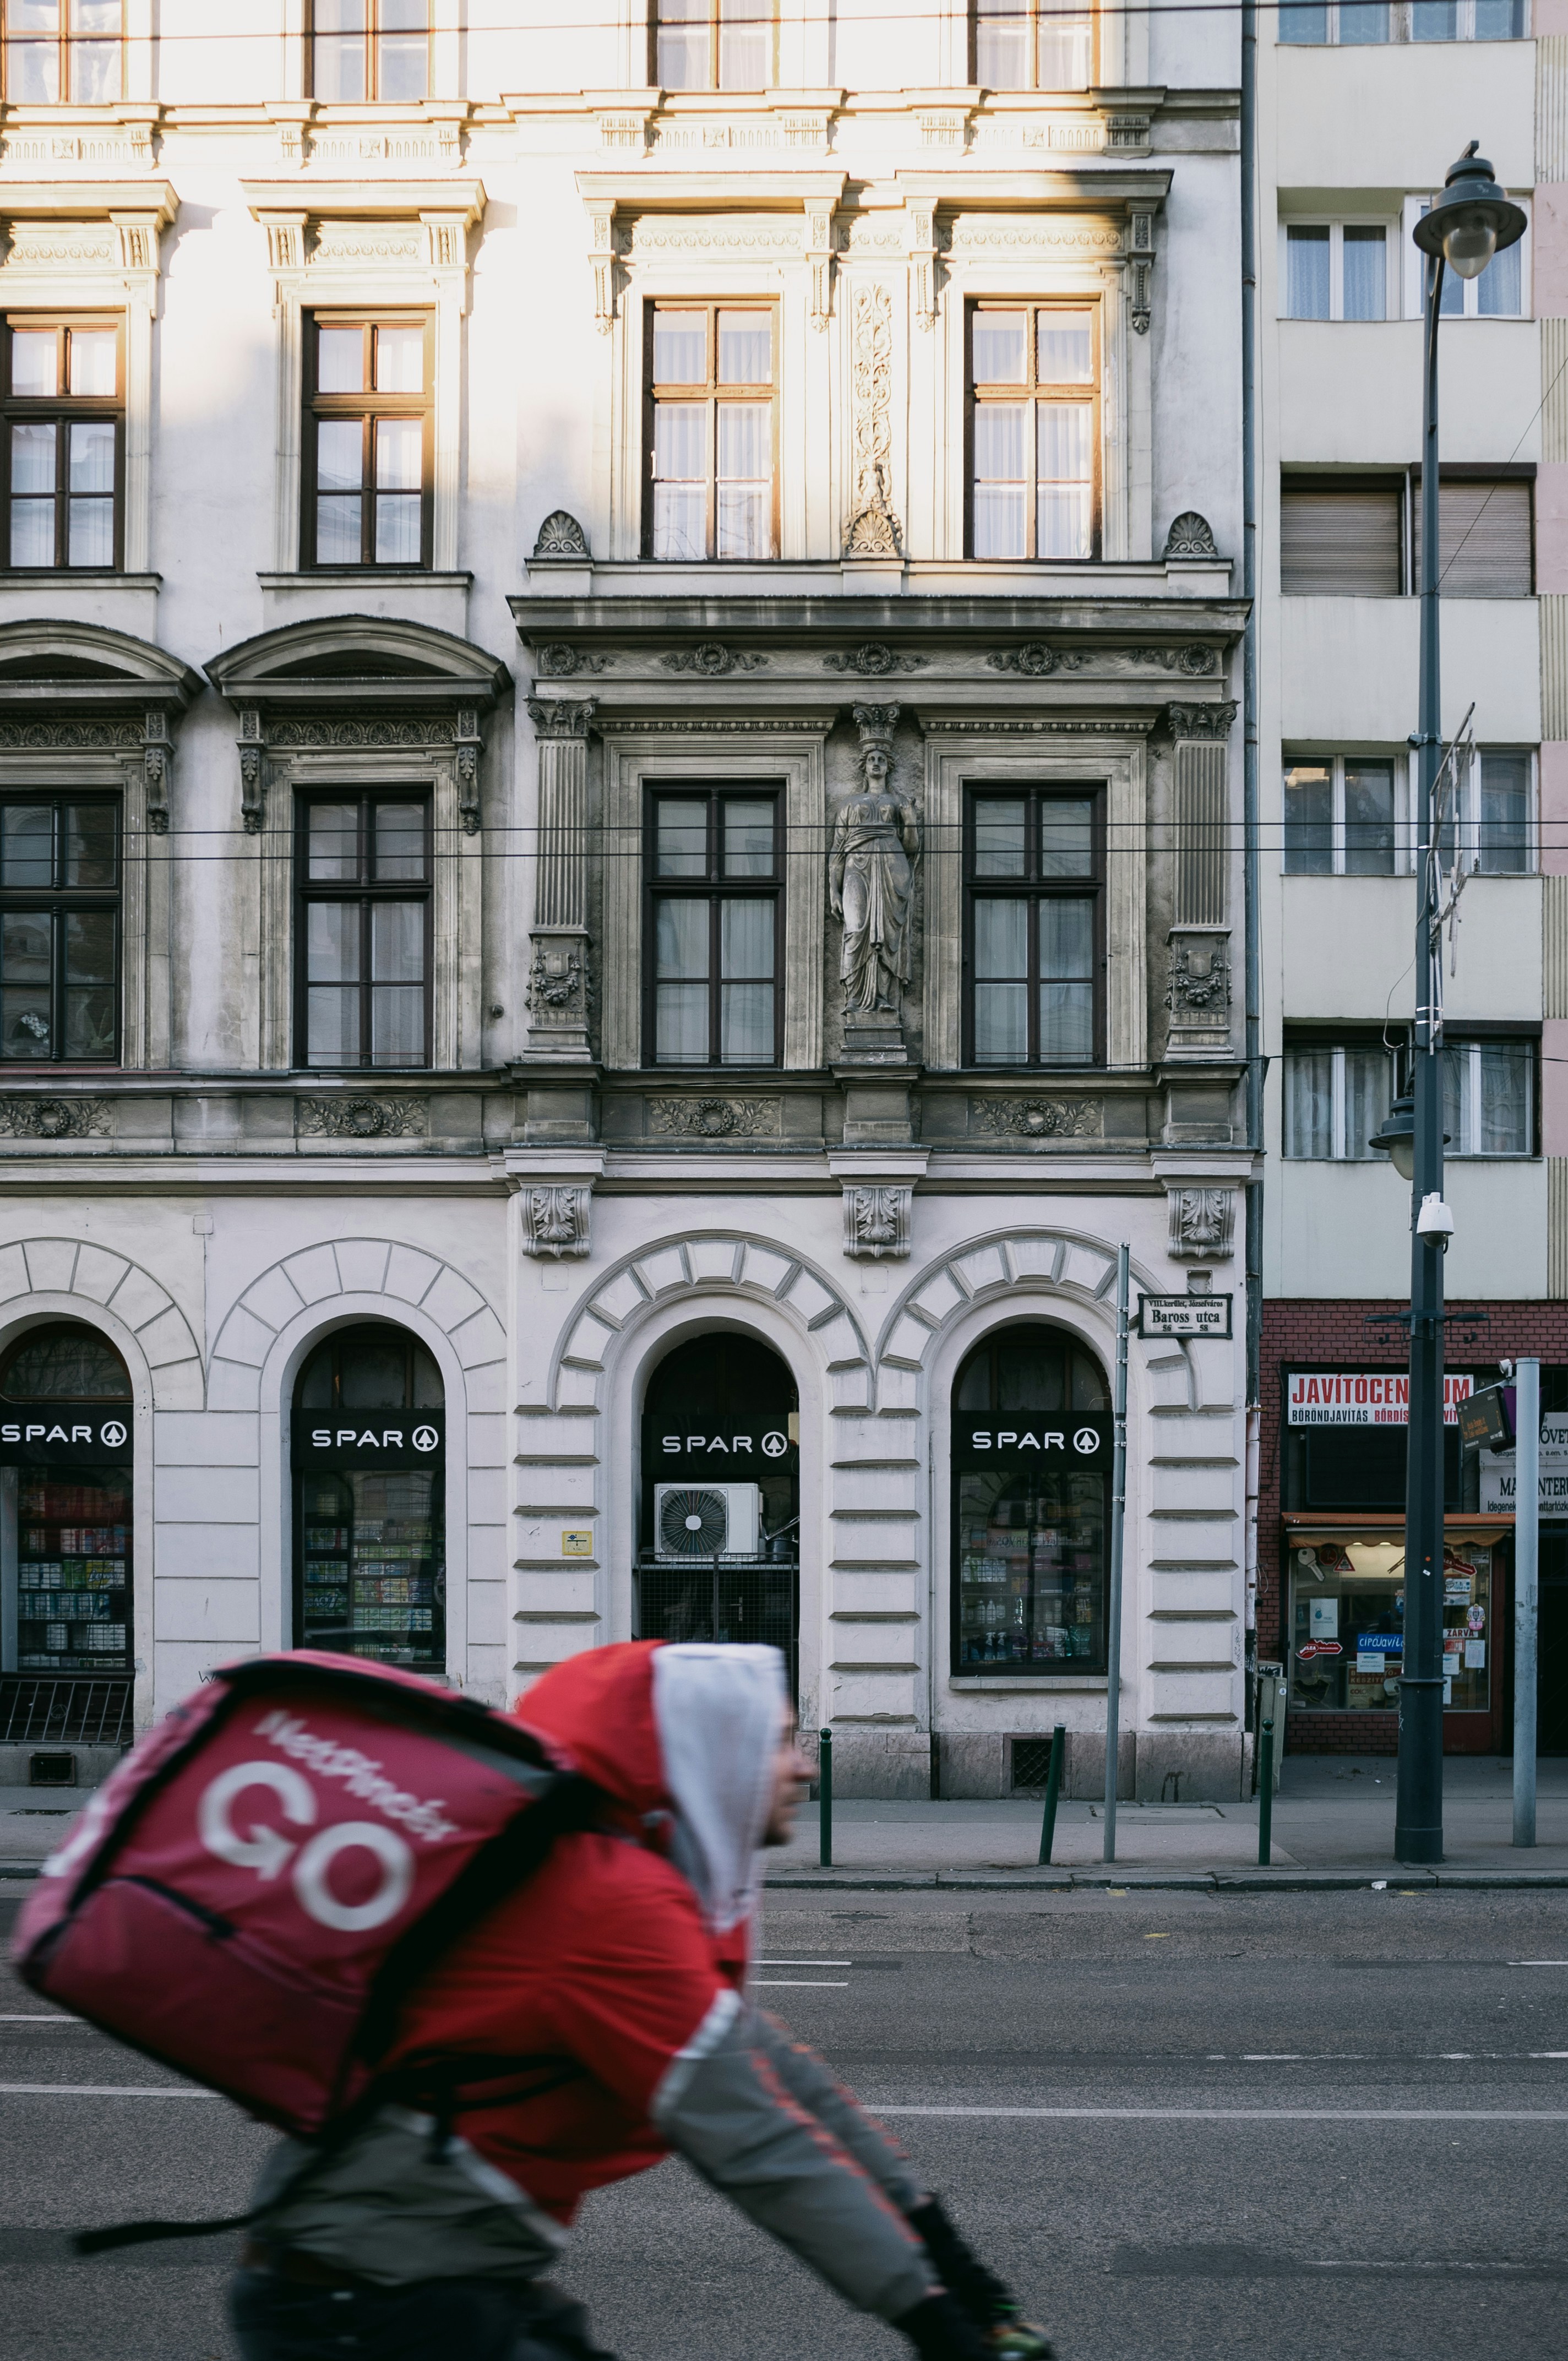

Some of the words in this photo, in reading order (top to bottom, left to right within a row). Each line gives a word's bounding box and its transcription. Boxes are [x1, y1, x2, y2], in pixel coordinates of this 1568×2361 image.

[1189, 1299, 1223, 1308] Józsefváros
[1152, 1309, 1190, 1323] Baross
[1196, 1311, 1220, 1323] utca
[1292, 1408, 1368, 1422] BÖRÖNDJAVÍTÁS
[1, 1424, 92, 1443] SPAR
[312, 1430, 403, 1448] SPAR
[972, 1432, 1065, 1449] SPAR
[662, 1436, 753, 1453] SPAR
[197, 1761, 417, 1932] GO
